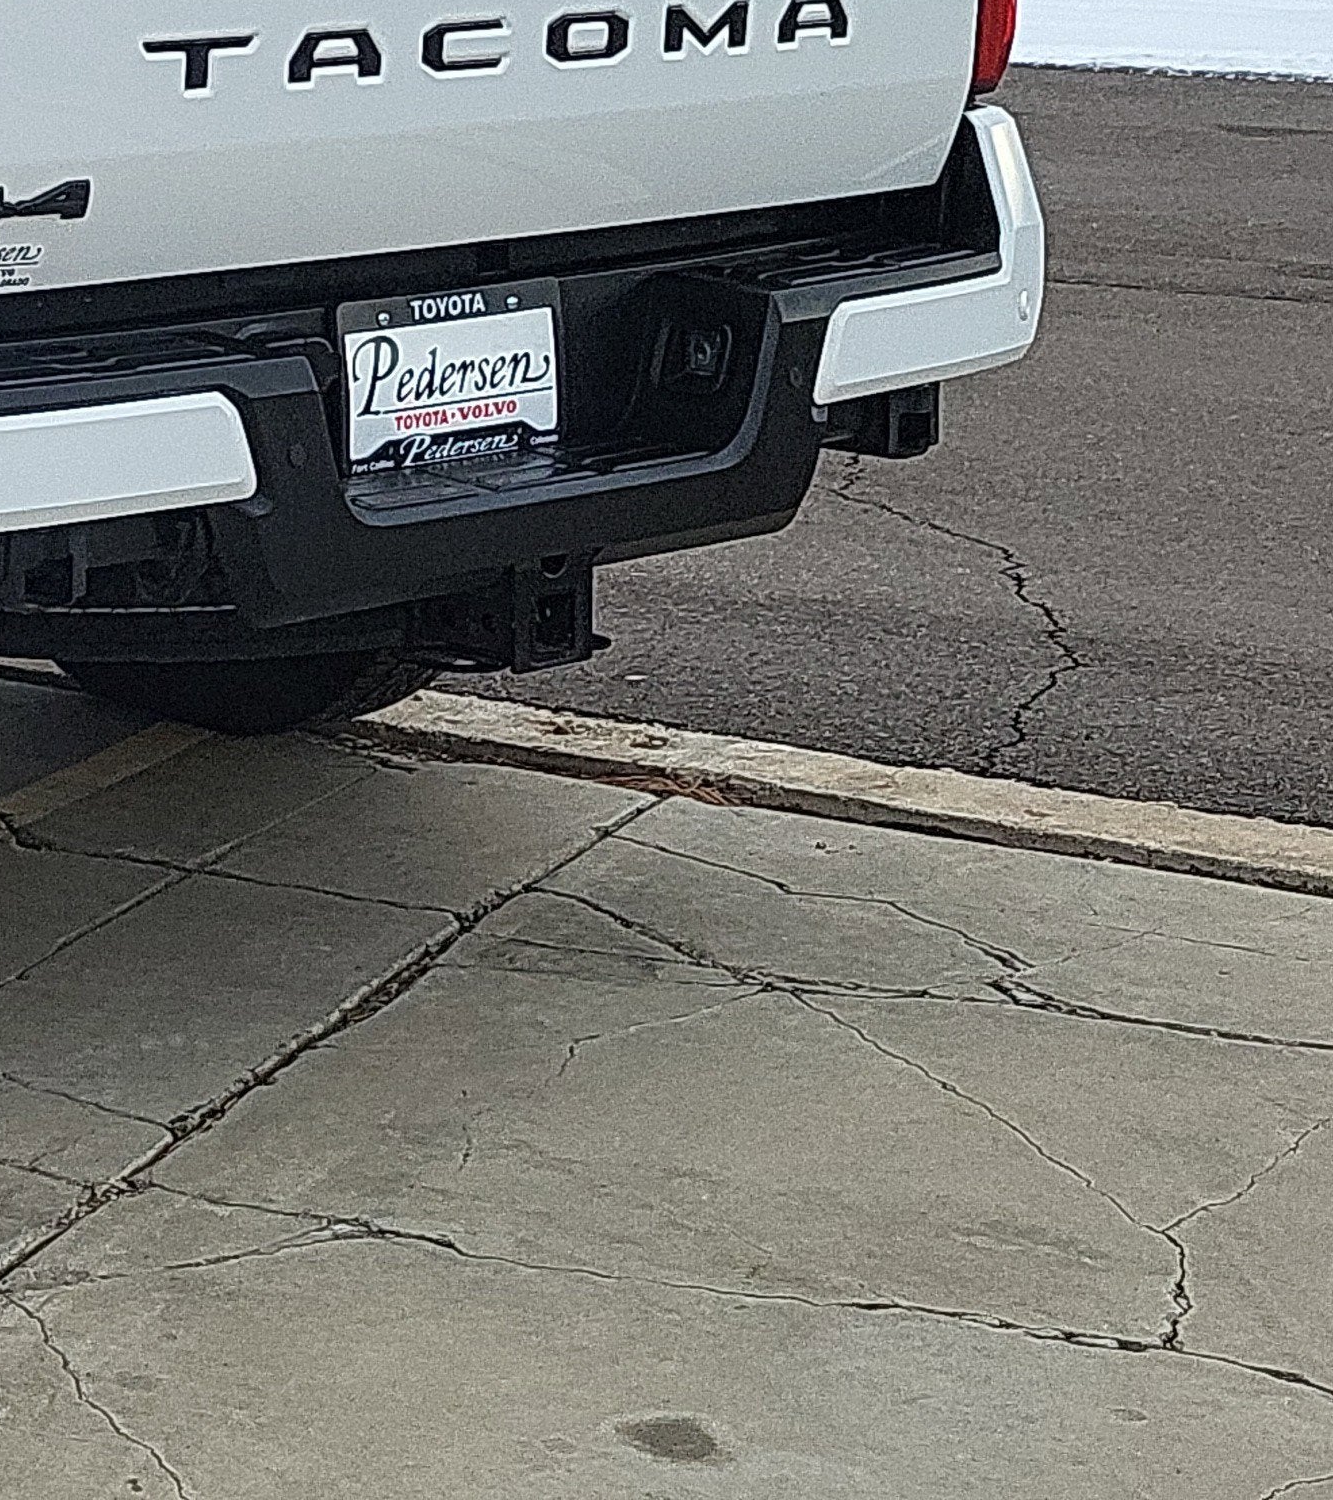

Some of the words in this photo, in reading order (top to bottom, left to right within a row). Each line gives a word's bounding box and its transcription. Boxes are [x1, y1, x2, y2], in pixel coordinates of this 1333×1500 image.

[409, 292, 486, 321] TOYOTA
[352, 334, 551, 418] Pedersen
[399, 433, 520, 468] Pedersen
